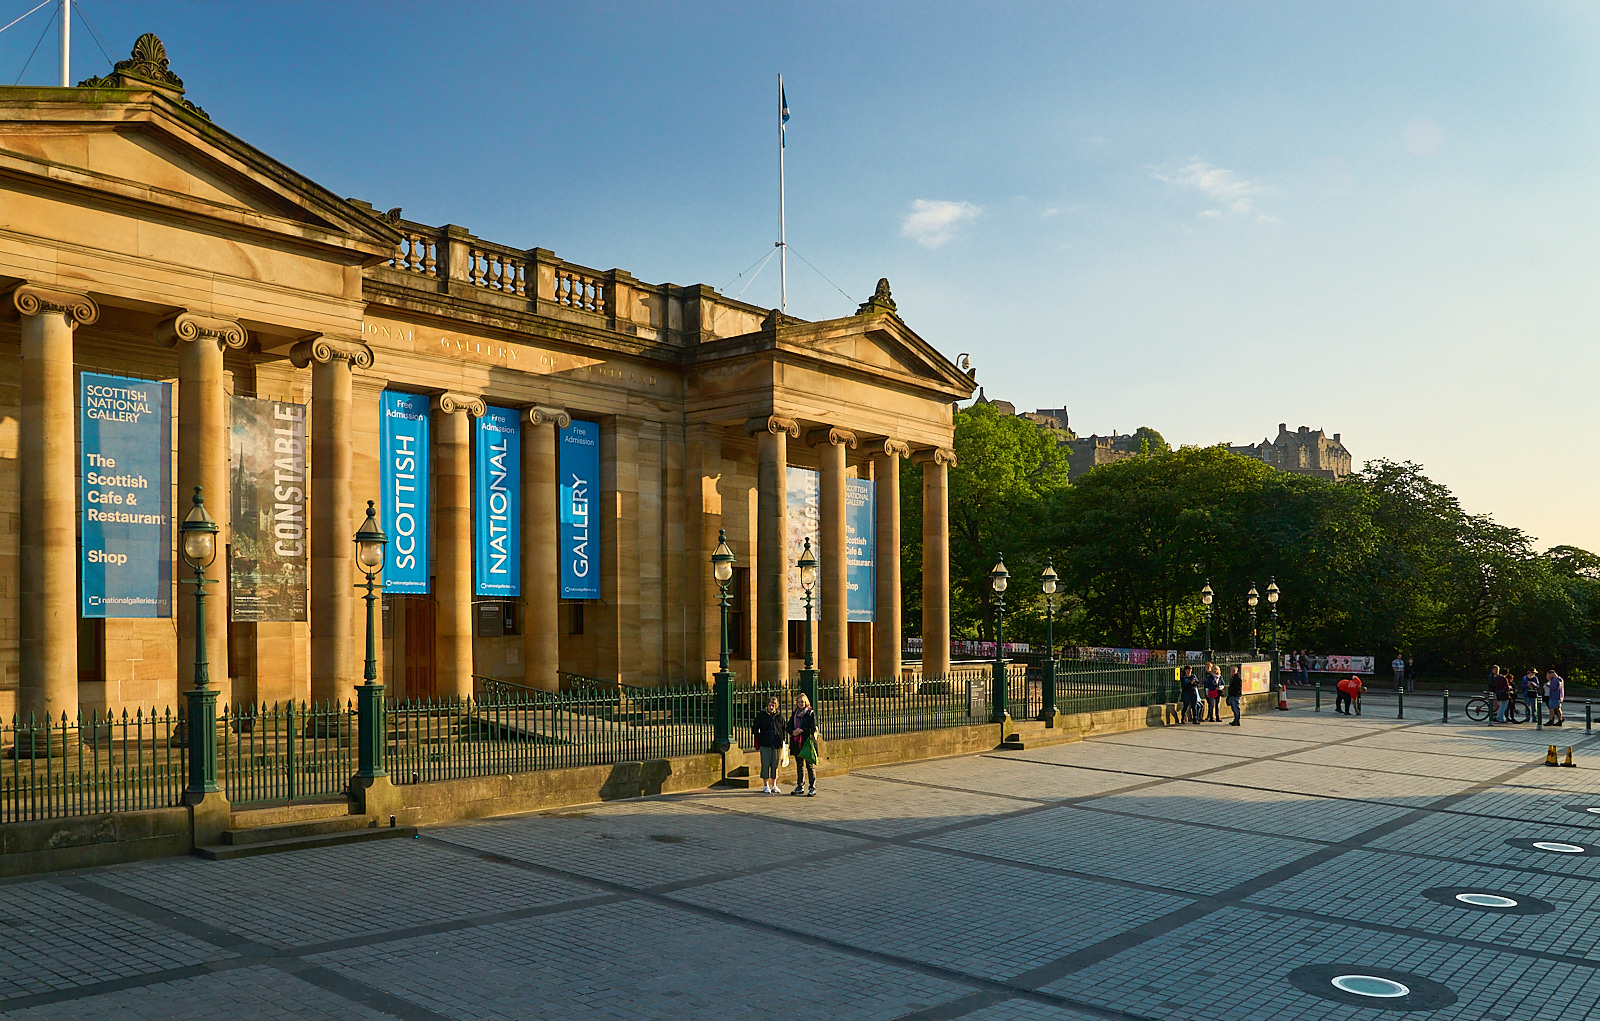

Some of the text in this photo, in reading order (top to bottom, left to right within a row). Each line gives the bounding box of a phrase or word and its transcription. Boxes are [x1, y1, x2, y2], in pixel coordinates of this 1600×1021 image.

[441, 336, 520, 361] GALLERY
[540, 355, 559, 367] OF
[86, 384, 147, 402] SCOTTISH
[87, 396, 152, 414] NATIONAL
[396, 399, 413, 409] Free
[87, 408, 140, 423] GALLERY
[386, 409, 424, 421] Admission
[491, 413, 506, 422] Free
[481, 422, 515, 434] Admission
[573, 426, 586, 435] Free
[564, 435, 595, 446] Admission
[86, 453, 116, 468] The
[87, 471, 148, 489] Scottish
[274, 404, 303, 556] CONSTABLE
[87, 490, 138, 506] Cafe &
[395, 435, 416, 570] SCOTTISH
[489, 438, 508, 574] NATIONAL
[88, 508, 167, 525] Restaurant
[572, 472, 589, 578] GALLERY
[87, 549, 128, 566] Shop
[857, 547, 863, 556] &
[102, 597, 167, 605] nationalgalleries.org
